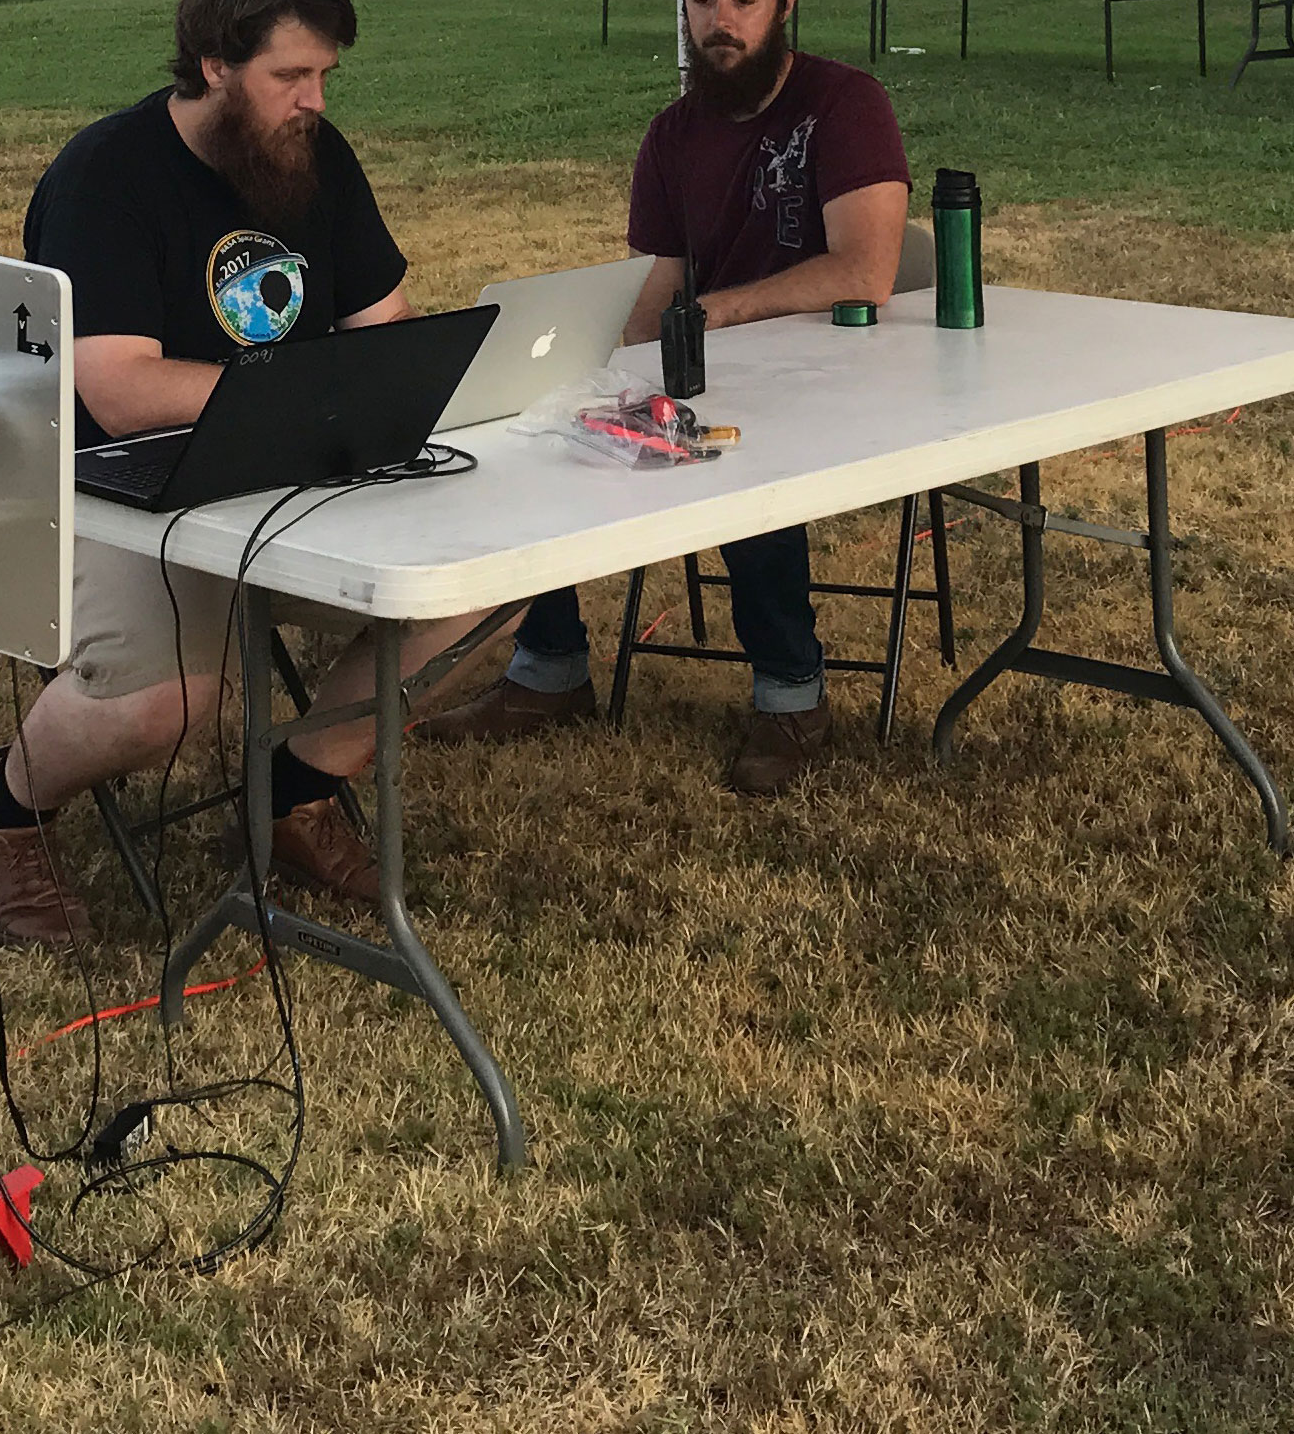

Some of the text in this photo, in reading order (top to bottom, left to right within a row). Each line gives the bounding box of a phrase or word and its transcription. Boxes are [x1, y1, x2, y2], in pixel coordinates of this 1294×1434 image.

[219, 237, 238, 255] NASA
[237, 235, 254, 244] Space
[219, 250, 252, 280] 2017
[19, 319, 26, 330] V
